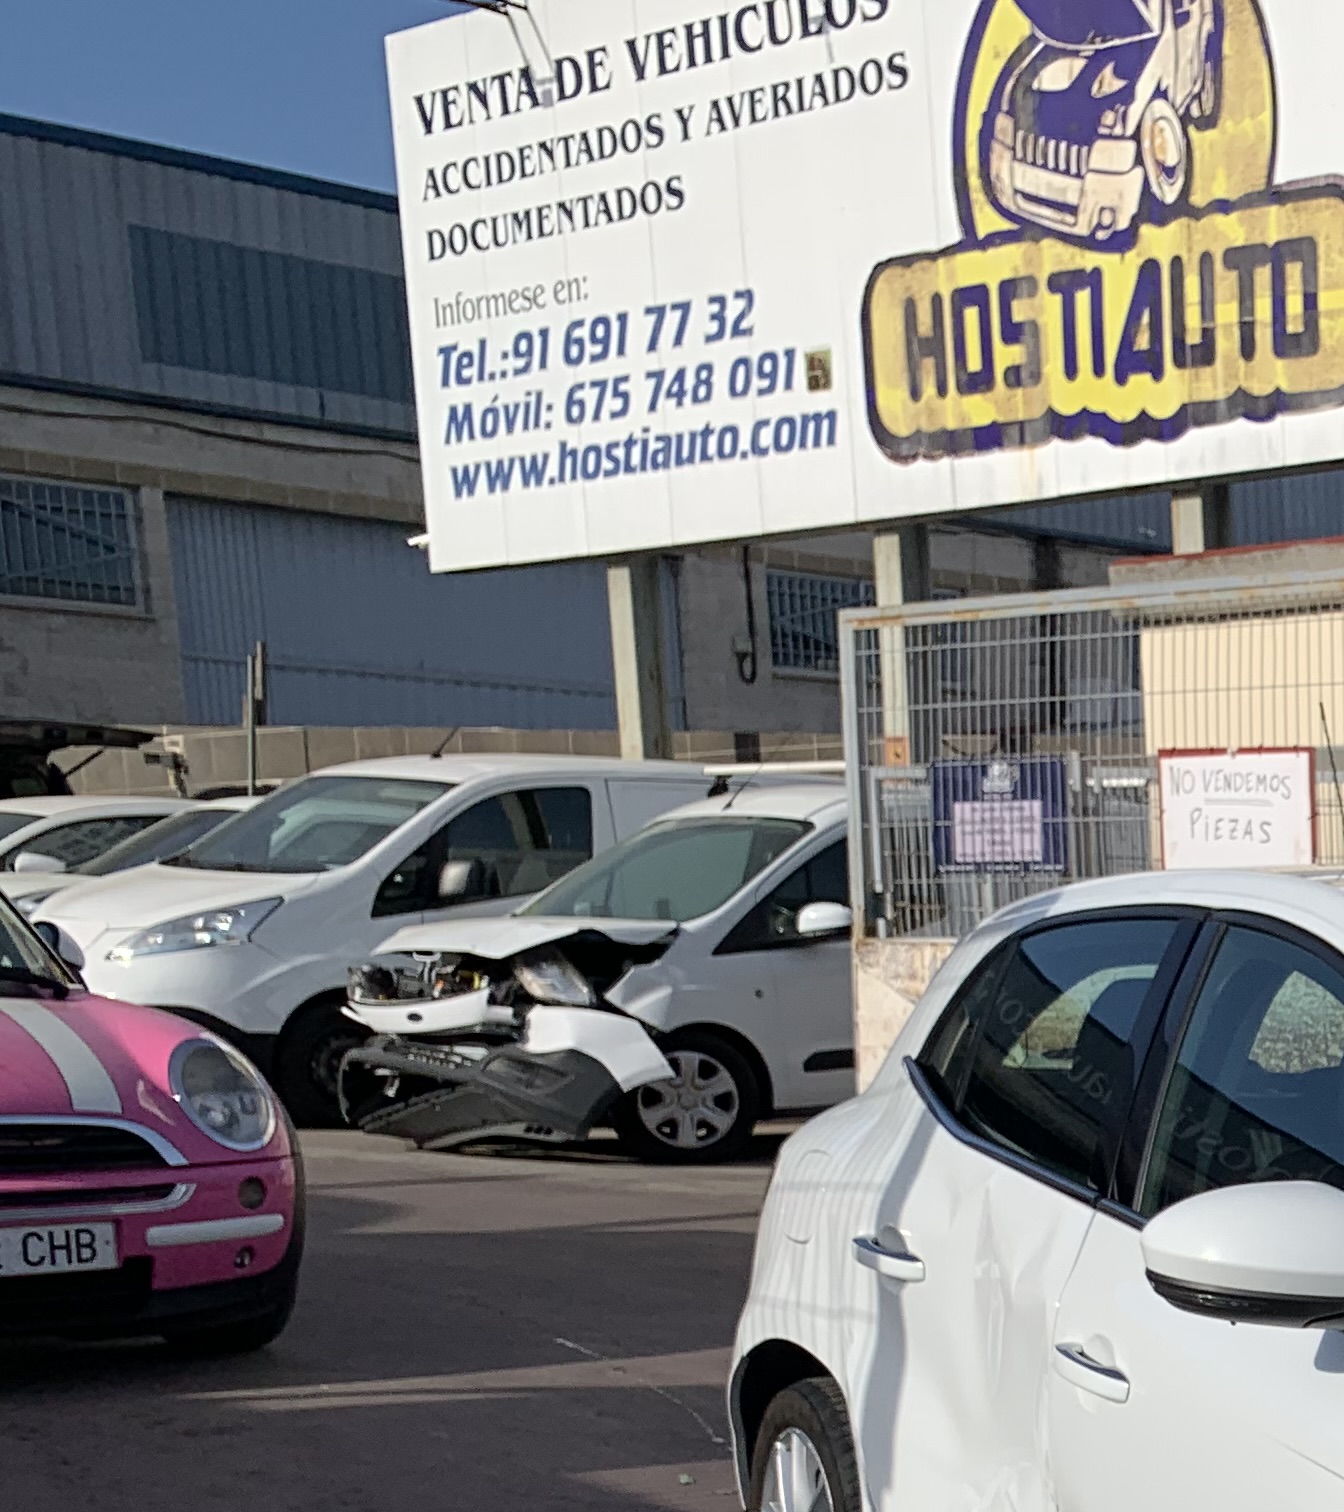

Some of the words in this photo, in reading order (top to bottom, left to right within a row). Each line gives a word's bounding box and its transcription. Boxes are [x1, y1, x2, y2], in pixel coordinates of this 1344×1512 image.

[413, 64, 542, 137] VENTA
[553, 46, 613, 104] DE
[422, 112, 665, 202] ACCIDENTADOS
[673, 104, 697, 143] Y
[703, 50, 911, 138] AVERIADOS
[426, 175, 686, 262] DOCUMENTADOS
[552, 274, 590, 306] en:
[562, 310, 629, 368] 691
[643, 300, 693, 354] 77
[704, 288, 755, 344] 32
[903, 236, 1320, 403] HOSTIAUTO
[443, 392, 554, 446] Móvil:
[564, 374, 631, 426] 675
[645, 361, 715, 415] 748
[728, 347, 797, 402] 091
[450, 408, 838, 500] www.hostiauto.com
[1168, 764, 1196, 797] NO
[1201, 768, 1293, 801] VENDEMOS
[21, 1228, 98, 1268] CHB
